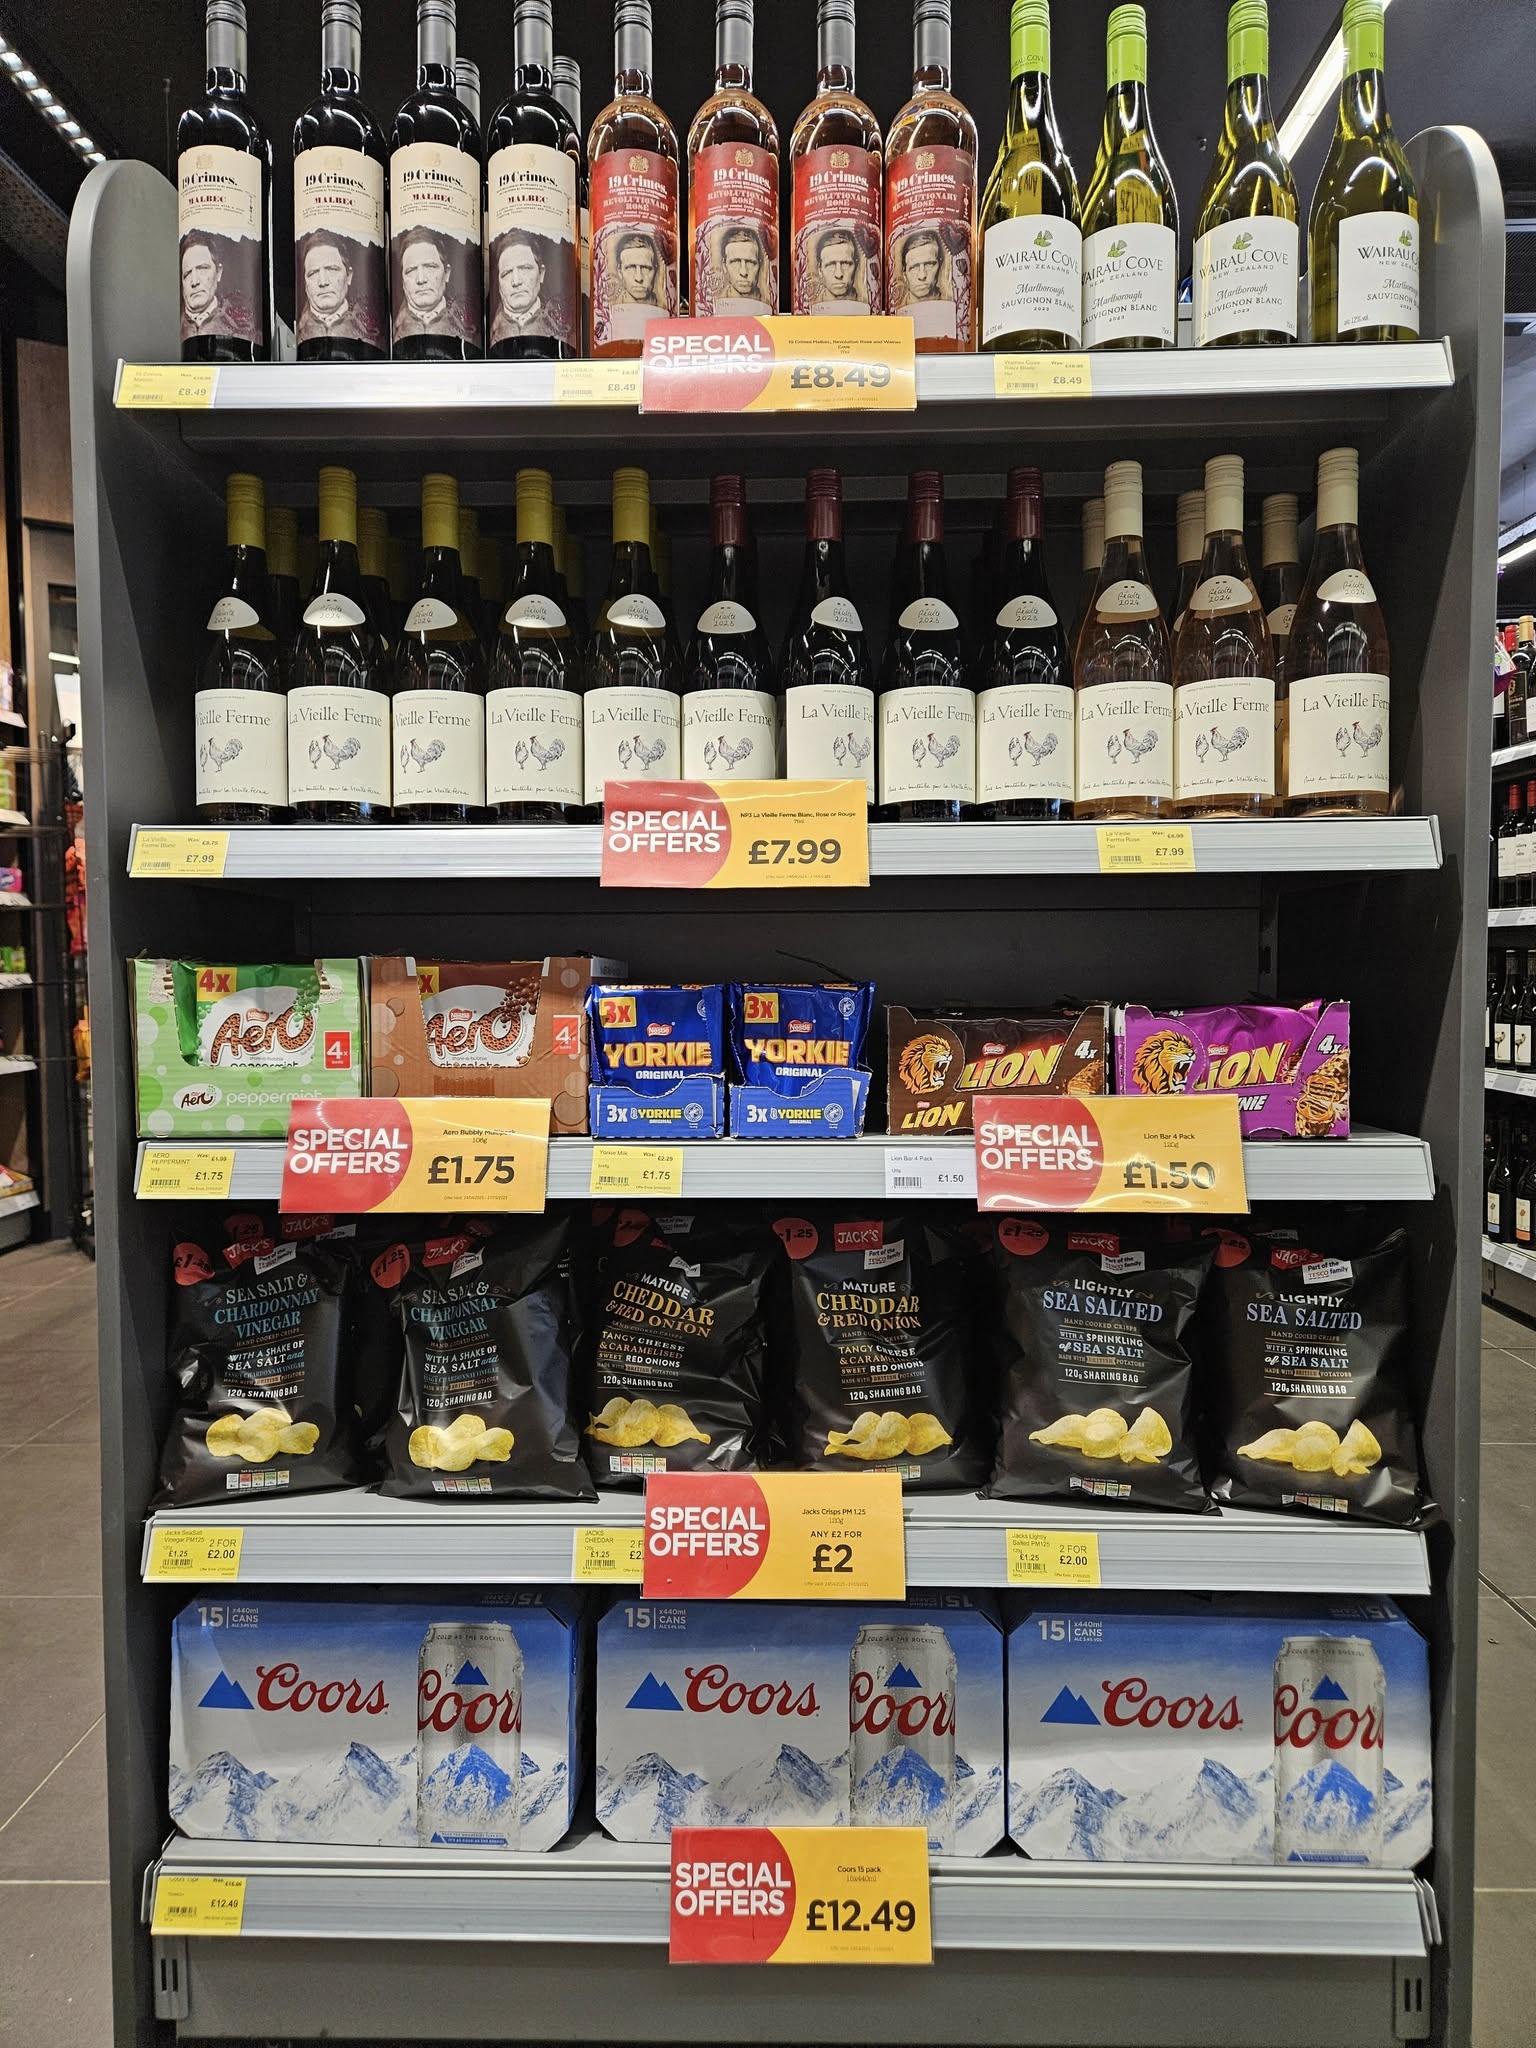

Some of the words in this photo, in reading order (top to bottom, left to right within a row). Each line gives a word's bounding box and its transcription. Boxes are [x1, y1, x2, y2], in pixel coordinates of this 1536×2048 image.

[305, 175, 316, 187] 19
[403, 171, 415, 183] 19
[714, 169, 727, 182] 19
[315, 195, 356, 206] MALBEC
[412, 194, 454, 204] MALBEC
[708, 190, 772, 206] REVOLUTIONARY
[995, 250, 1048, 270] WAIRAU
[1051, 250, 1079, 275] COVE
[1012, 263, 1030, 272] NEW
[1036, 263, 1070, 275] ZEALAND
[1199, 250, 1247, 279] WAIRAU
[1251, 248, 1288, 266] COVE
[1015, 283, 1065, 296] Marlborough
[1001, 296, 1052, 310] SAUVIGNON
[1054, 297, 1075, 312] BLANC
[1203, 298, 1253, 319] SAUVIGNON
[1256, 296, 1283, 306] BLANC
[649, 334, 771, 354] SPECIAL
[649, 353, 763, 374] OFFERS
[790, 364, 892, 388] £8.49
[1053, 376, 1082, 385] £8.49
[178, 388, 207, 396] £8.49
[607, 383, 636, 392] £8.49
[887, 710, 899, 725] La
[901, 705, 943, 721] Vieille
[1186, 697, 1228, 716] Vieille
[1233, 696, 1270, 713] Ferme
[289, 711, 299, 725] La
[300, 706, 340, 722] Vieille
[344, 707, 382, 727] Ferme
[491, 710, 503, 726] La
[504, 707, 546, 722] Vieille
[609, 810, 727, 832] SPECIAL
[797, 811, 815, 819] Blanc,
[608, 832, 721, 853] OFFERS
[748, 838, 842, 865] £7.99
[1155, 847, 1184, 856] £7.99
[185, 854, 214, 863] £7.99
[199, 969, 231, 994] 4x
[746, 996, 774, 1019] 3x
[603, 1041, 713, 1069] YORKIE
[744, 1038, 851, 1067] YORKIE
[635, 1070, 685, 1080] ORIGINAL
[775, 1067, 825, 1078] ORIGINAL
[638, 1108, 682, 1119] YORKIE
[778, 1109, 822, 1120] YORKIE
[293, 1127, 408, 1151] SPECIAL
[979, 1124, 1098, 1147] SPECIAL
[290, 1151, 401, 1175] OFFERS
[427, 1155, 515, 1184] £1.75
[981, 1148, 1094, 1171] OFFERS
[195, 1171, 223, 1181] £1.75
[642, 1170, 671, 1180] £1.75
[938, 1174, 964, 1183] £1.50
[1123, 1161, 1216, 1189] £1.50
[837, 1229, 880, 1245] JACK'S
[226, 1287, 256, 1305] SEA
[257, 1276, 295, 1298] SALT
[297, 1272, 308, 1288] &
[640, 1272, 690, 1300] MATURE
[842, 1281, 896, 1294] MATURE
[1074, 1278, 1135, 1299] LIGHTLY
[214, 1287, 321, 1325] CHARDONNAY
[613, 1280, 715, 1326] CHEDDAR
[816, 1292, 920, 1315] CHEDDAR
[1043, 1290, 1080, 1313] SEA
[1085, 1295, 1163, 1323] SALTED
[1280, 1293, 1344, 1308] LIGHTLY
[235, 1310, 301, 1339] VINEGAR
[817, 1312, 831, 1327] &
[833, 1314, 868, 1328] RED
[870, 1316, 922, 1332] ONION
[1246, 1302, 1288, 1325] SEA
[1295, 1307, 1363, 1330] SALTED
[1086, 1333, 1143, 1347] SPRINKLING
[247, 1388, 284, 1399] SHARING
[285, 1385, 298, 1396] BAG
[870, 1386, 904, 1399] SHARING
[905, 1385, 922, 1395] BAG
[650, 1506, 766, 1531] SPECIAL
[821, 1508, 841, 1517] Crisps
[209, 1539, 215, 1548] 2
[217, 1538, 237, 1547] FOR
[649, 1532, 760, 1556] OFFERS
[1067, 1545, 1087, 1554] FOR
[207, 1549, 235, 1559] £2.00
[812, 1543, 853, 1573] £2
[1059, 1555, 1088, 1565] £2.00
[198, 1607, 223, 1627] 15
[232, 1614, 259, 1623] CANS
[624, 1607, 651, 1628] 15
[658, 1608, 686, 1616] x440ml
[659, 1615, 687, 1624] CANS
[1037, 1620, 1065, 1642] 15
[1074, 1628, 1103, 1637] CANS
[256, 1662, 389, 1715] Coors
[684, 1664, 820, 1717] Coors
[1102, 1677, 1243, 1731] Coors
[675, 1862, 792, 1888] SPECIAL
[837, 1865, 856, 1873] Coors
[857, 1865, 865, 1873] 15
[865, 1865, 881, 1874] pack
[211, 1899, 238, 1908] £12.49
[675, 1889, 786, 1917] OFFERS
[806, 1898, 916, 1932] £12.49
